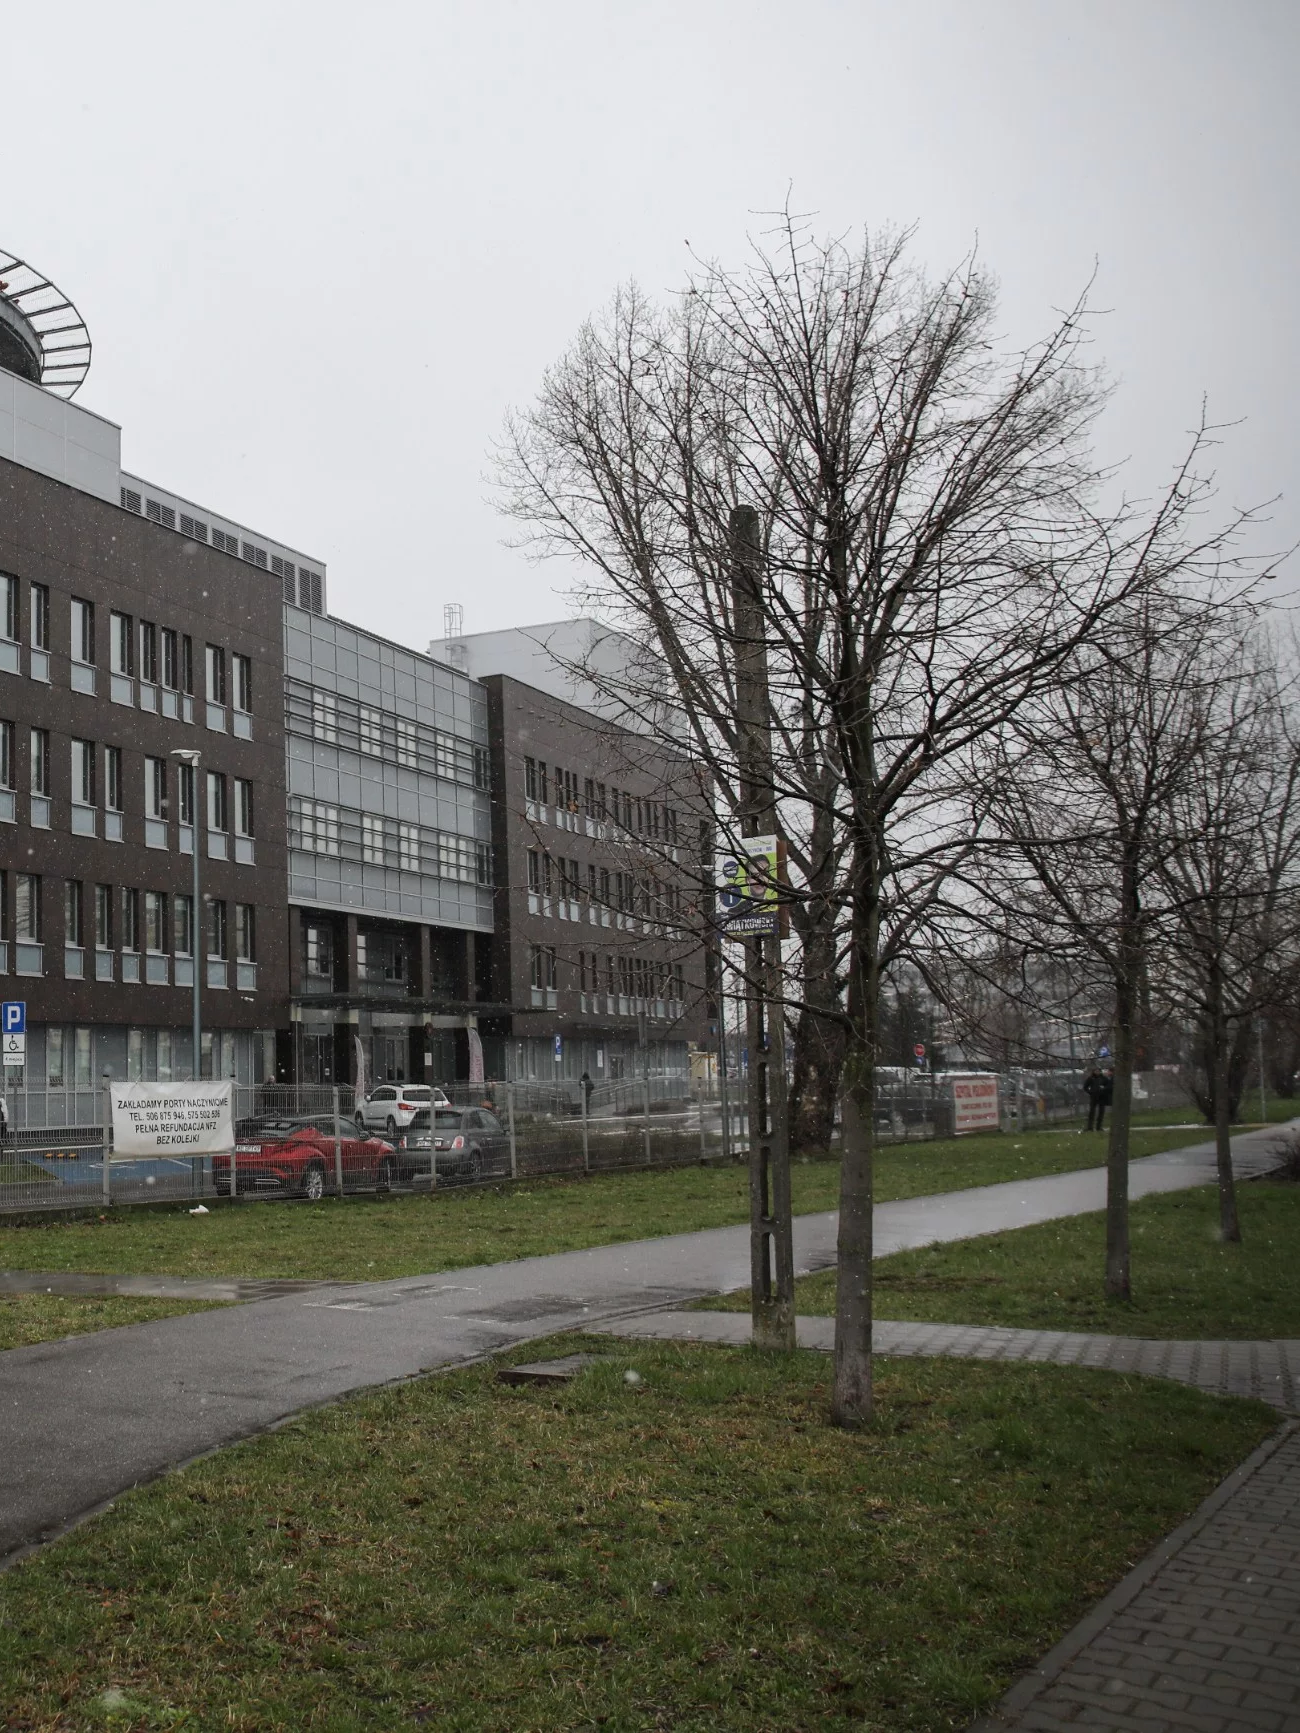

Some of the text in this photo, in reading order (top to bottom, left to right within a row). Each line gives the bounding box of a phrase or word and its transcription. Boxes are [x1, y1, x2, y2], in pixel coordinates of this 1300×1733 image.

[7, 1005, 21, 1030] P
[164, 1099, 186, 1109] PORTY
[187, 1097, 228, 1107] NACZYNIOWE
[129, 1112, 144, 1121] TEL.
[146, 1112, 158, 1121] 506
[160, 1111, 171, 1120] 875
[188, 1110, 199, 1120] 575
[200, 1110, 210, 1119] 502
[135, 1121, 217, 1133] PEŁNA REFUNDACJA NFZ
[156, 1134, 200, 1145] BEZ KOLEJKI
